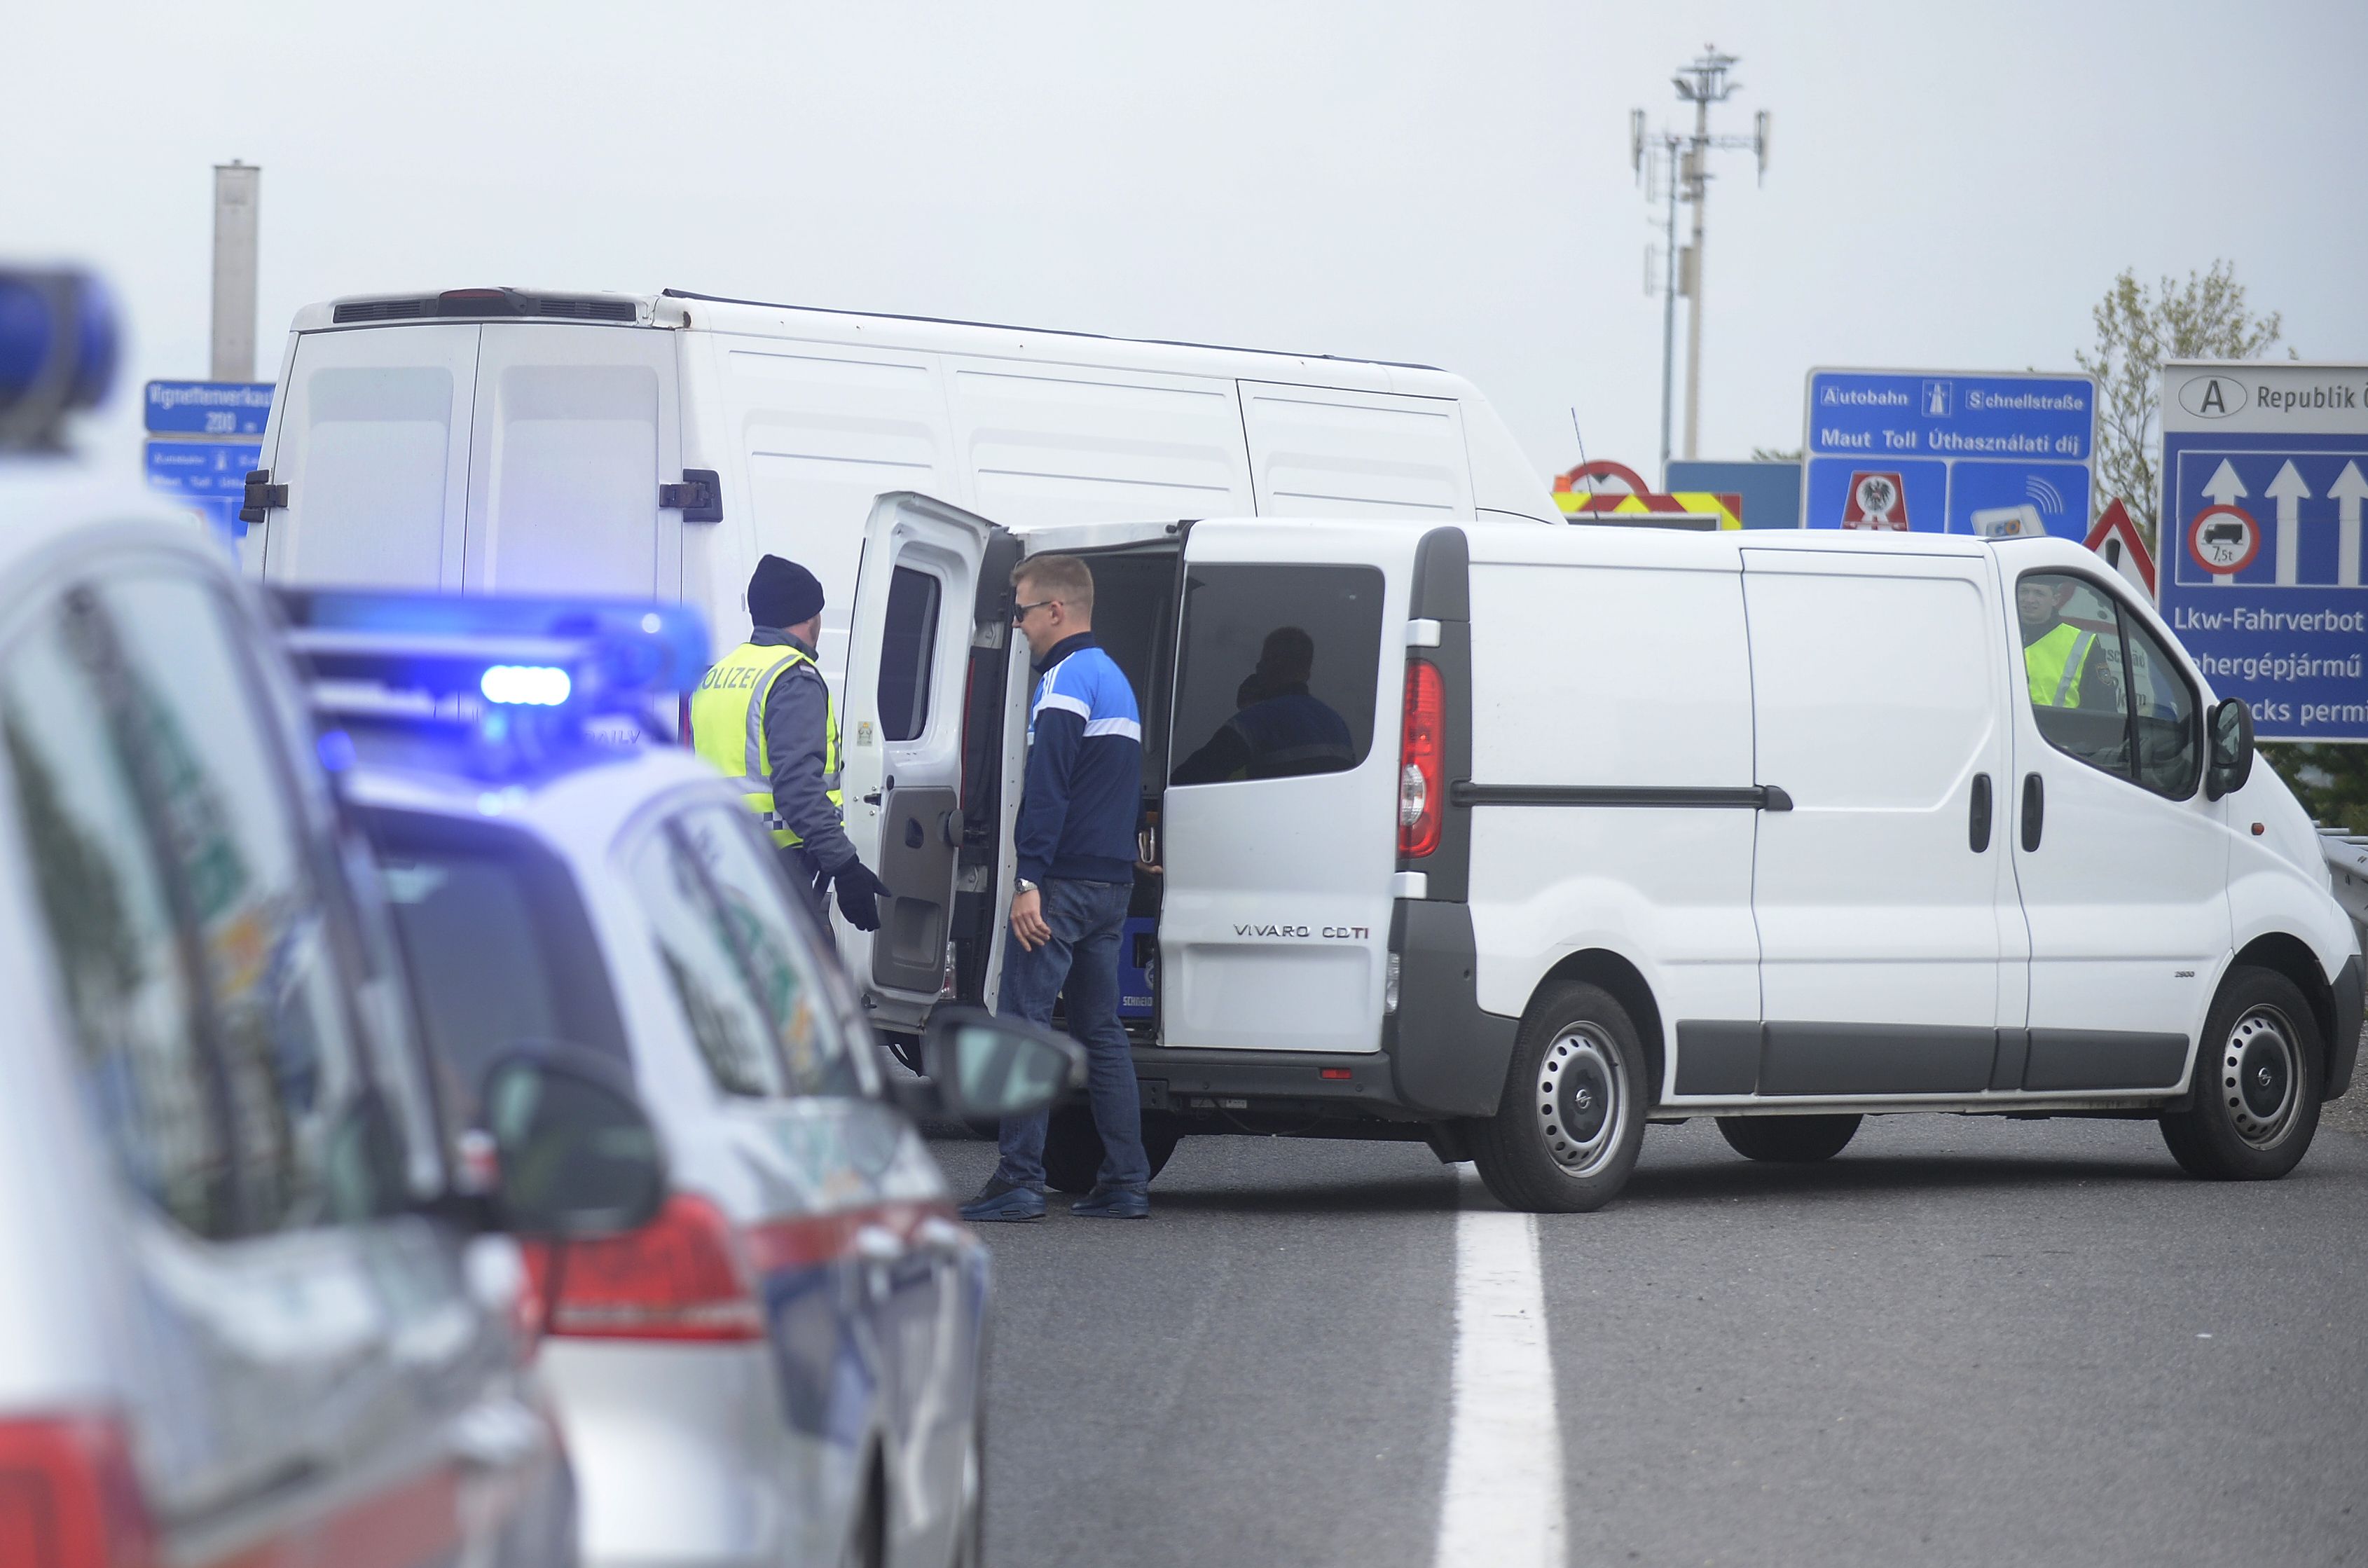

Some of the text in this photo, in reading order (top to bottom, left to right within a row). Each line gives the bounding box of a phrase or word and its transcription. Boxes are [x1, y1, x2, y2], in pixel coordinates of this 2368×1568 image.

[149, 384, 275, 411] Vignettenverkau
[1823, 386, 1908, 406] Autobahn
[1968, 391, 2085, 411] Schnellstraße
[2200, 379, 2226, 413] A
[2257, 385, 2355, 413] Republik
[1822, 427, 2080, 457] Maut Toll Úthasználati díj
[2212, 545, 2233, 561] 7,5t
[2174, 607, 2365, 631] Lkw-Fahrverbot
[701, 666, 764, 690] OLIZEI
[2246, 699, 2291, 722] cks
[1233, 923, 1370, 940] VIVARO CDTI
